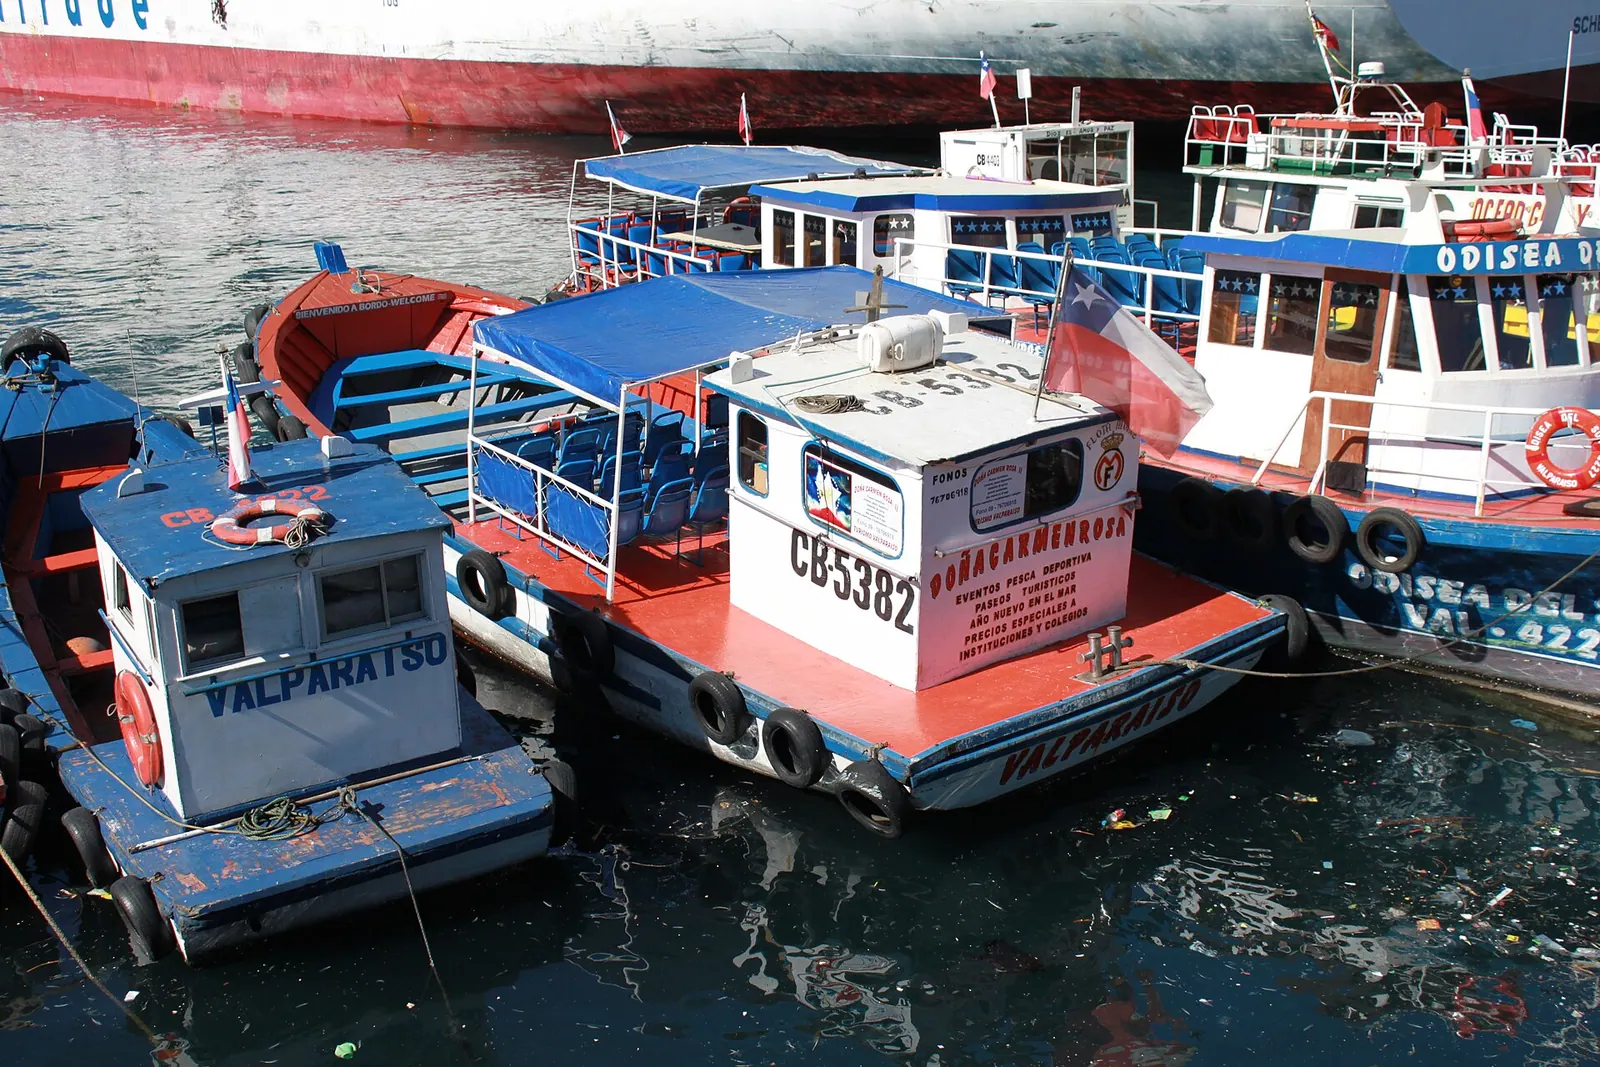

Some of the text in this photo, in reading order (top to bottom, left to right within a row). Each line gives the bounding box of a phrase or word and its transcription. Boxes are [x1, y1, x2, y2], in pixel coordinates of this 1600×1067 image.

[976, 153, 986, 166] CB
[1436, 241, 1562, 273] ODISEA
[295, 304, 350, 320] BIENVENIDO
[350, 304, 358, 312] A
[932, 468, 968, 486] FONOS
[1536, 463, 1578, 488] VALPARAISO
[930, 487, 969, 505] 76706918
[160, 507, 215, 528] CB
[955, 552, 1092, 606] EVENTOS PESCA DEPORTIVA
[975, 571, 1076, 614] PASEOS TURISTICOS
[1348, 562, 1490, 609] ODISEA
[1503, 587, 1585, 620] DEL
[964, 598, 1077, 646] PRECIOS ESPECIALES A
[969, 584, 1077, 630] AÑO NUEVO EN EL MAR
[1401, 603, 1480, 637] VAL
[959, 607, 1089, 662] INSTITUCIONES Y COLEGIOS
[206, 632, 448, 718] VALPARAISO
[999, 679, 1202, 785] VALPARAISO
